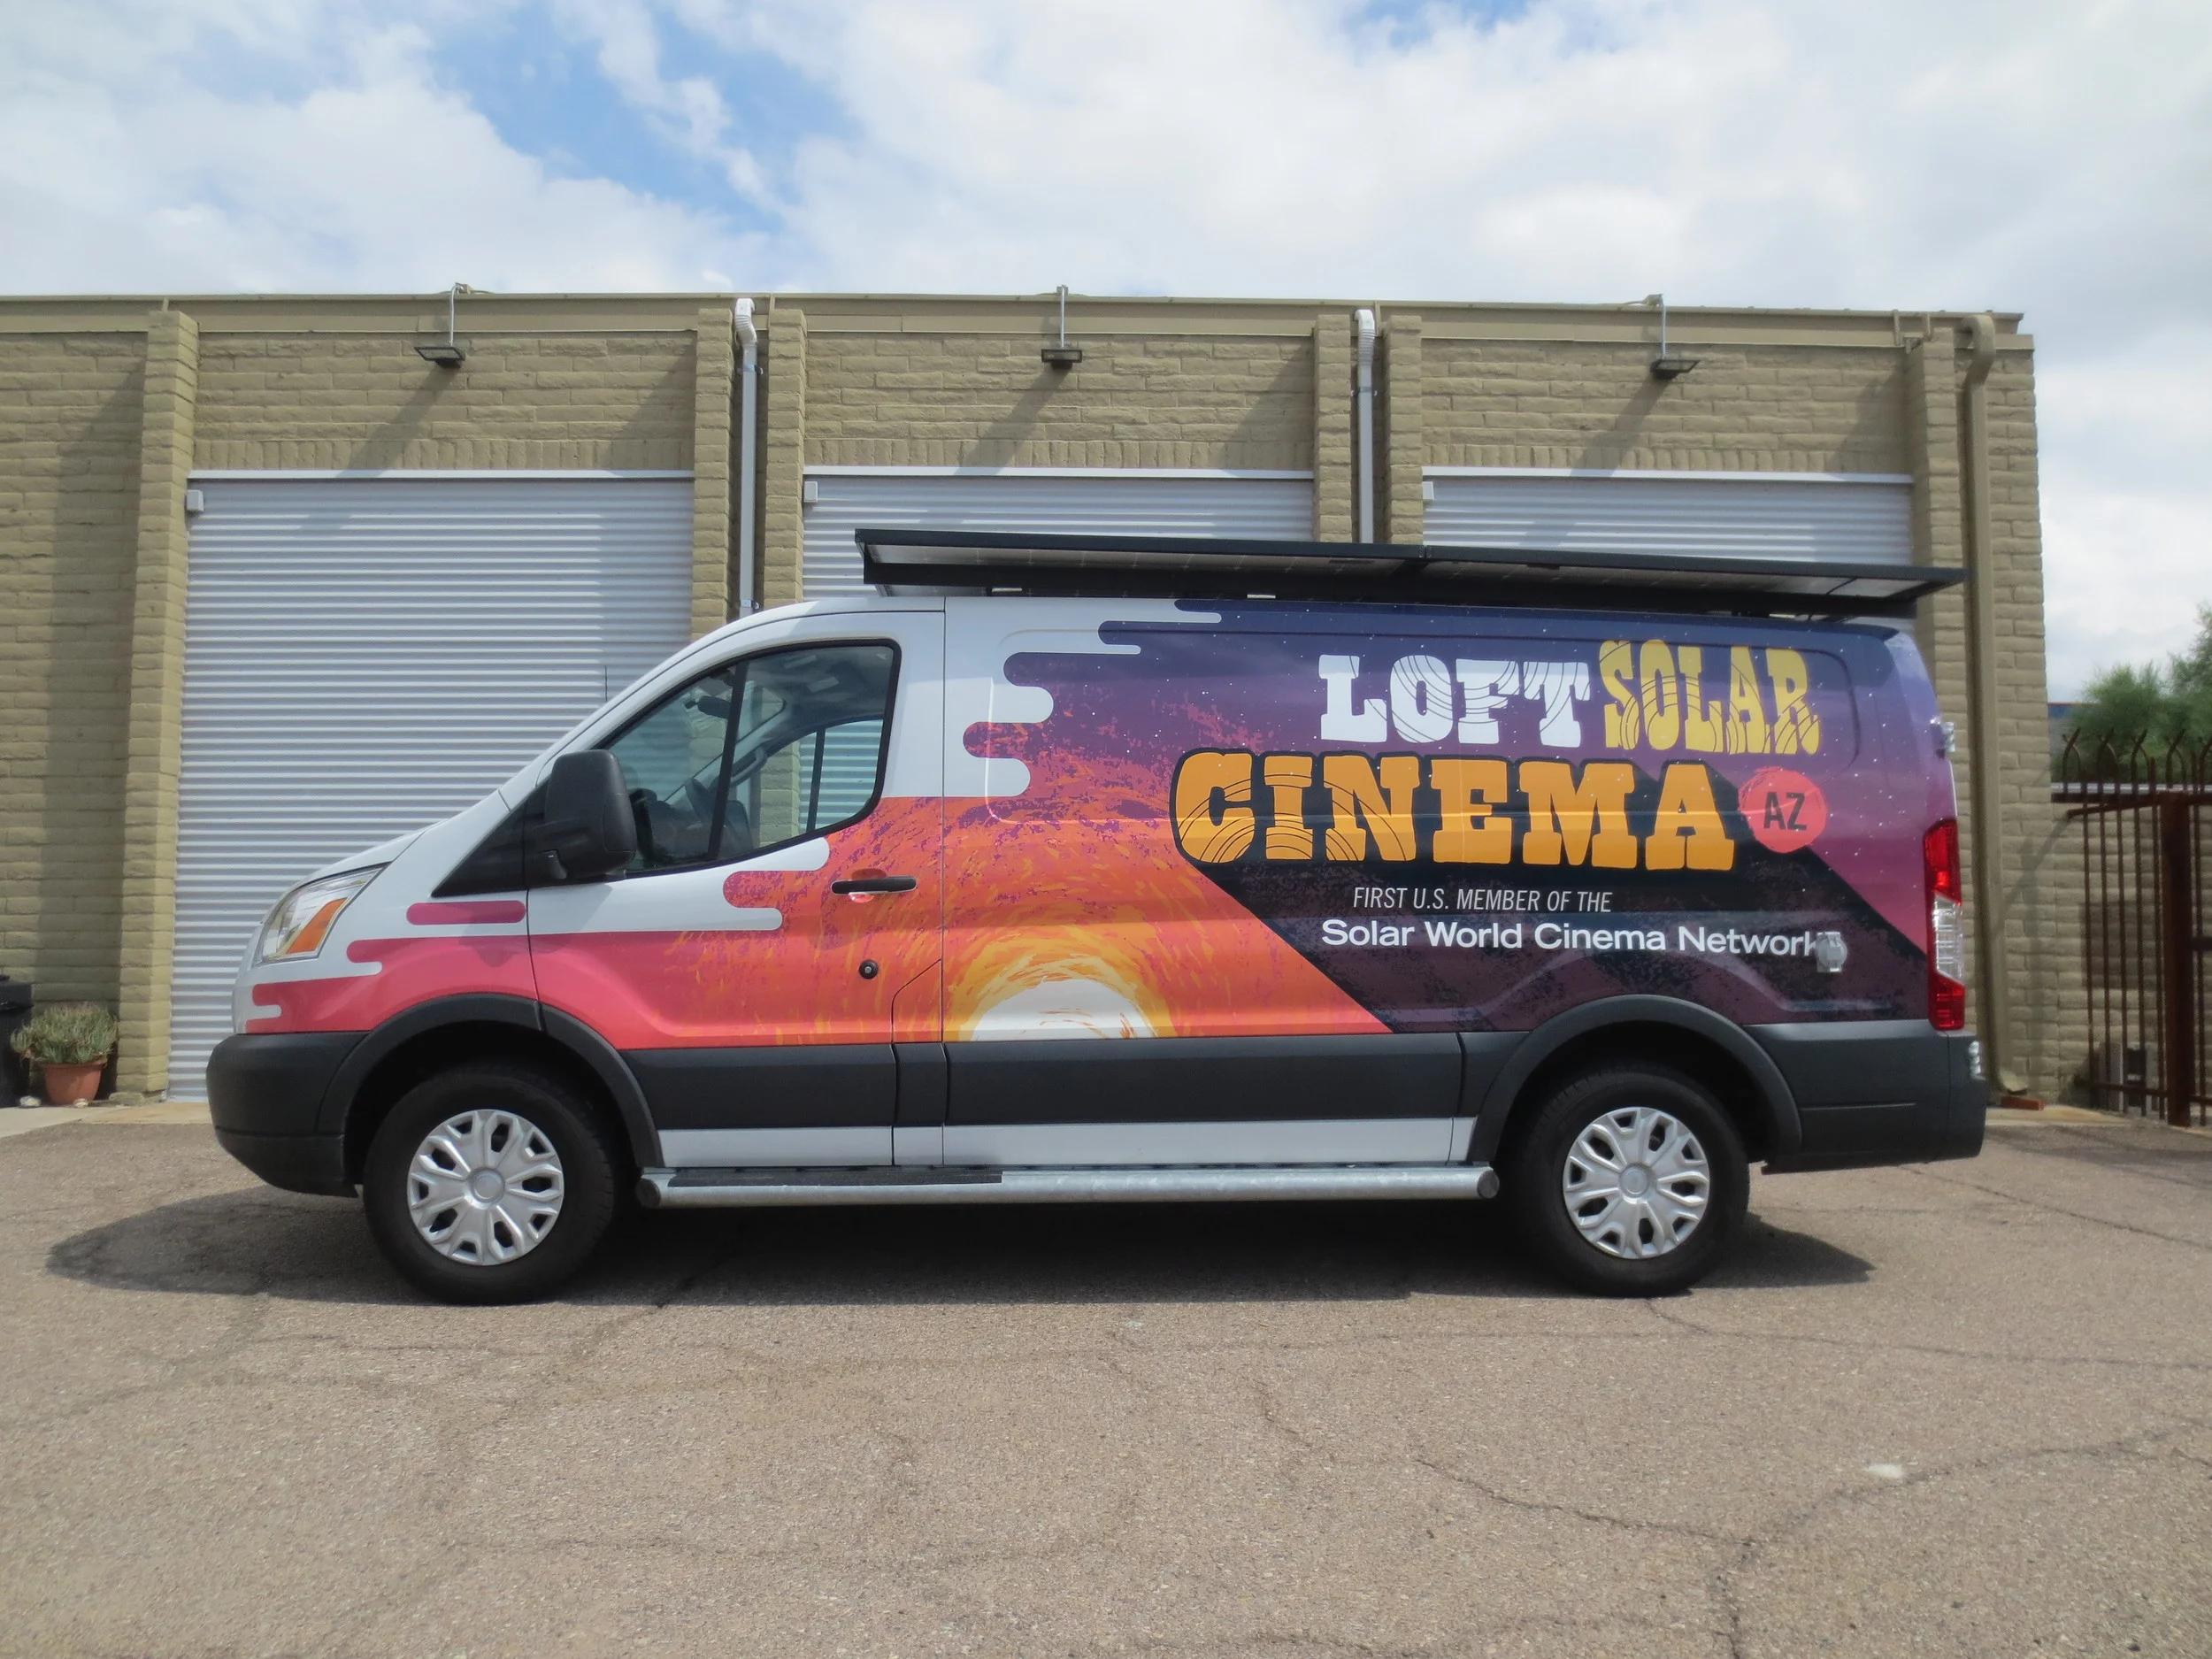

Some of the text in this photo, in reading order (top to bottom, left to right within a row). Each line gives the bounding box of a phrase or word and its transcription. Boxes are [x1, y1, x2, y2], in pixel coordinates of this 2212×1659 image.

[1318, 640, 1821, 755] LOFT SOLAR
[1177, 751, 1735, 871] CINEMA
[1763, 791, 1808, 832] AZ
[1353, 887, 1613, 912] FIRST U.S. MEMBER OF THE
[1322, 919, 1415, 947] Solar
[1424, 921, 1522, 949] World
[1534, 922, 1667, 951] Cinema
